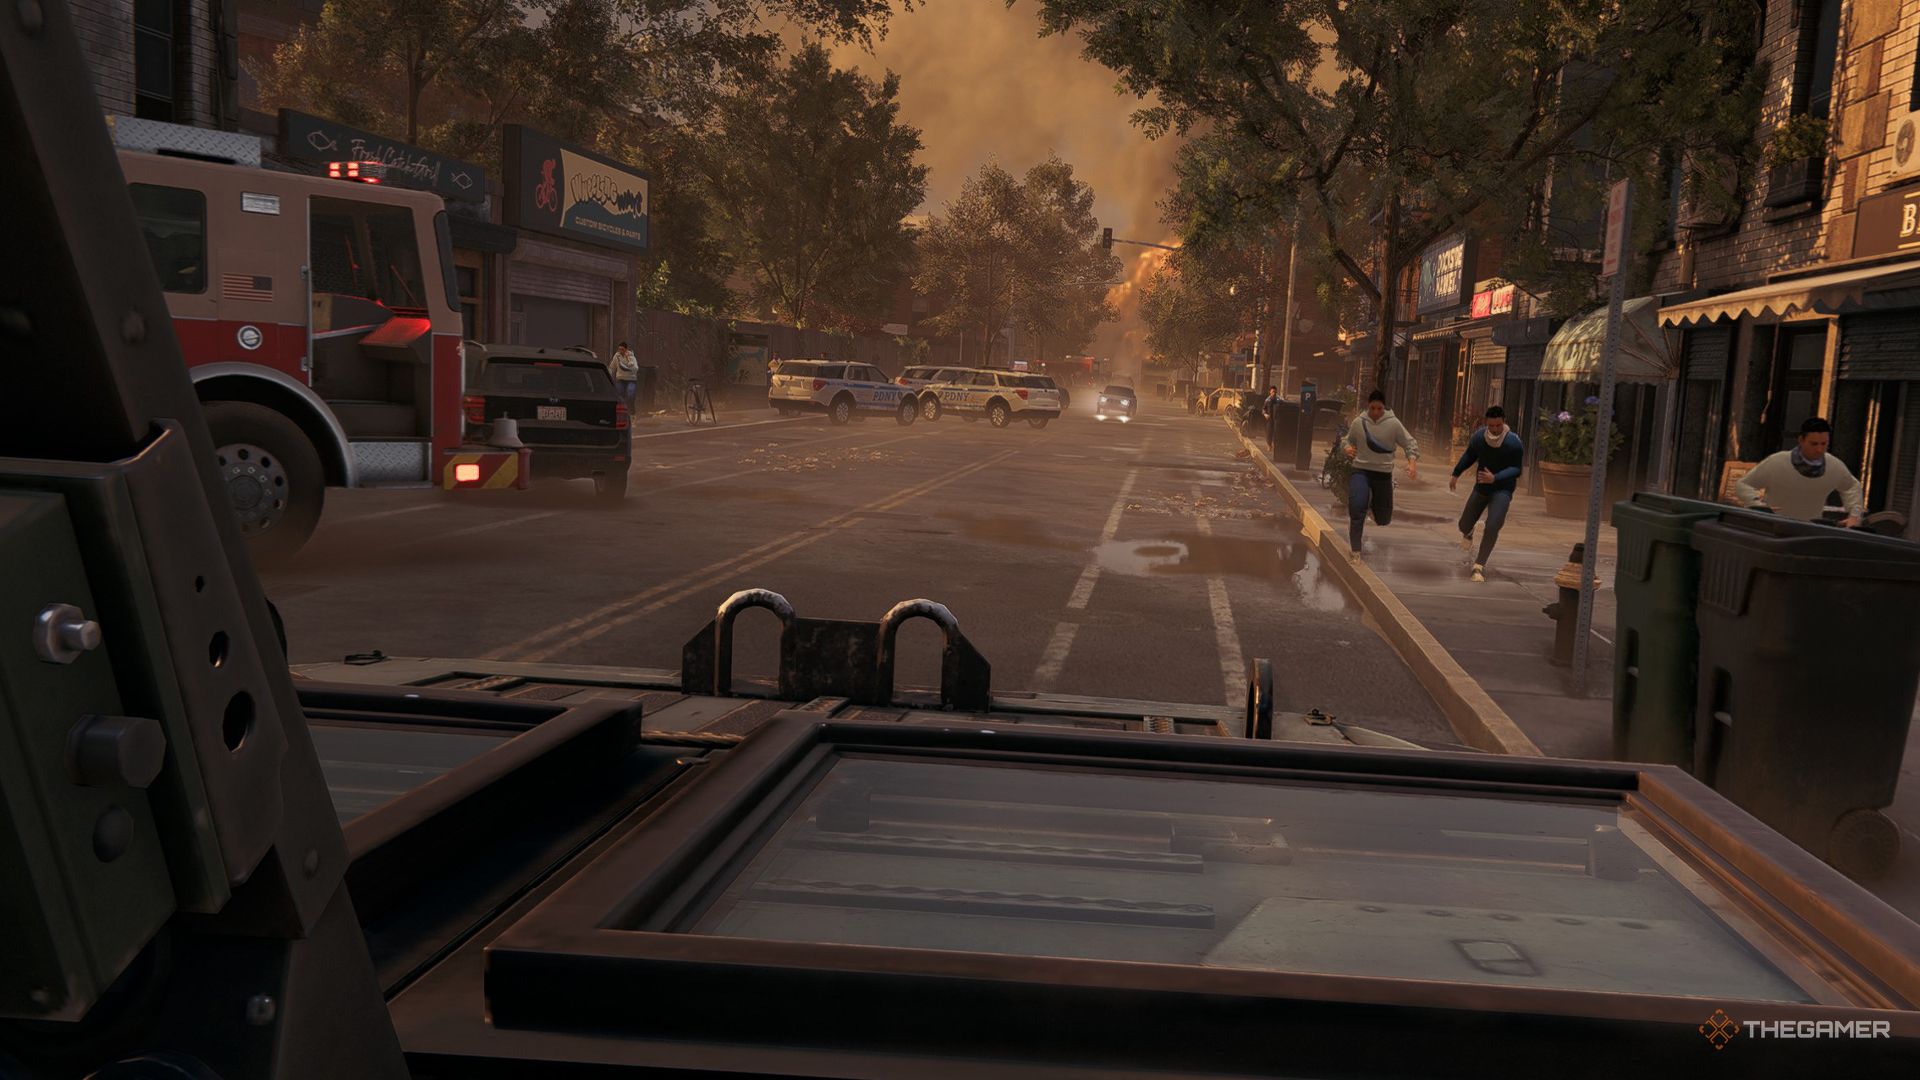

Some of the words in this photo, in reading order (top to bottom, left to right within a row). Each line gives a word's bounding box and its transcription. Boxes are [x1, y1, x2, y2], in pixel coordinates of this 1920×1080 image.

[575, 216, 598, 229] CUSTOM
[598, 220, 622, 236] BICYCLES
[626, 229, 641, 240] PARTS
[1900, 203, 1920, 238] B
